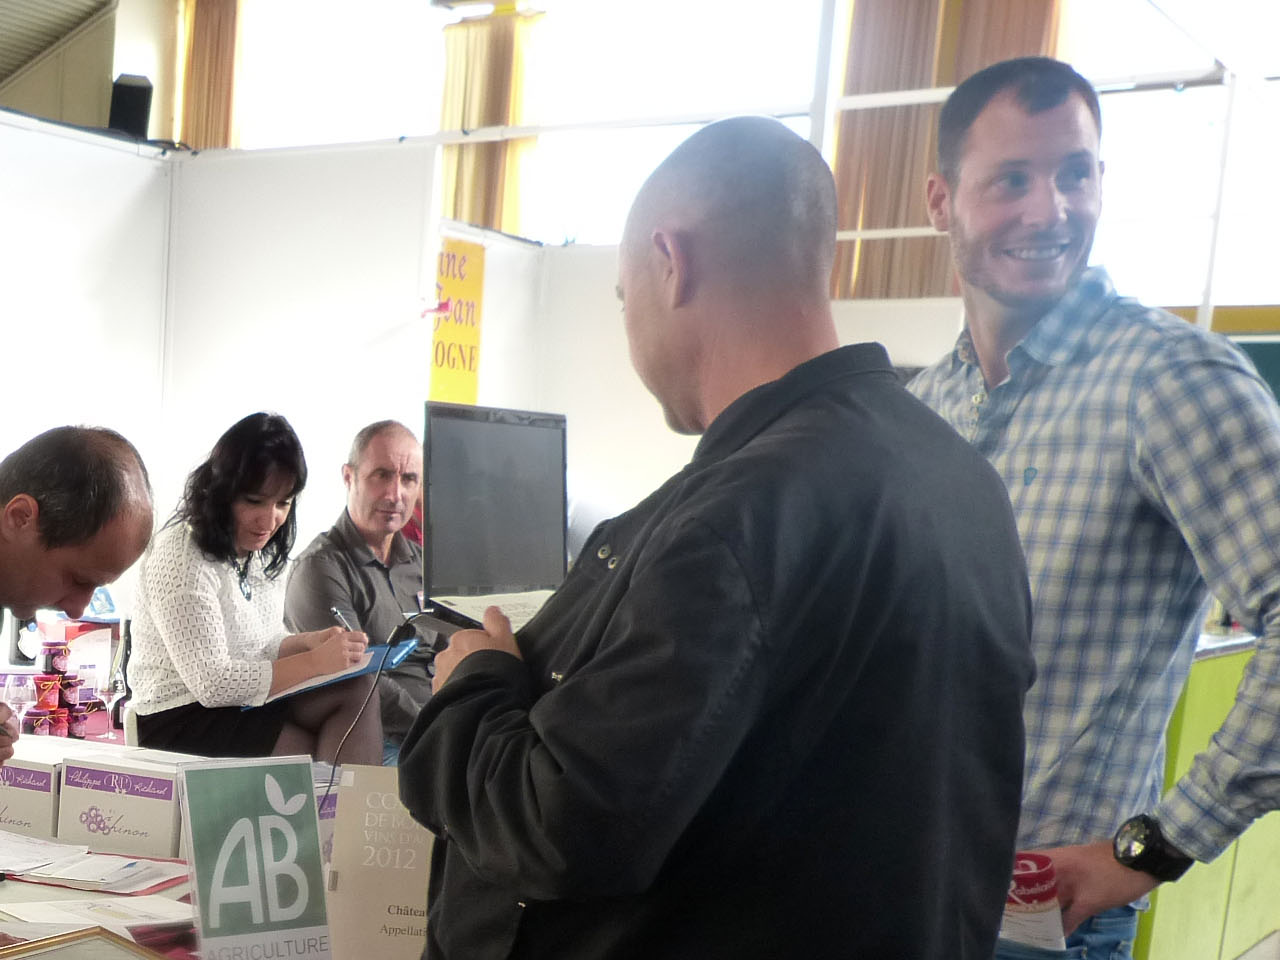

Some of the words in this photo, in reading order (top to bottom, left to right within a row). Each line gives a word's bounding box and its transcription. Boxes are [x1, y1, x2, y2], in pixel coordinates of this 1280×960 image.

[134, 780, 168, 795] Richard
[362, 845, 417, 870] 2012
[209, 814, 310, 929] AB
